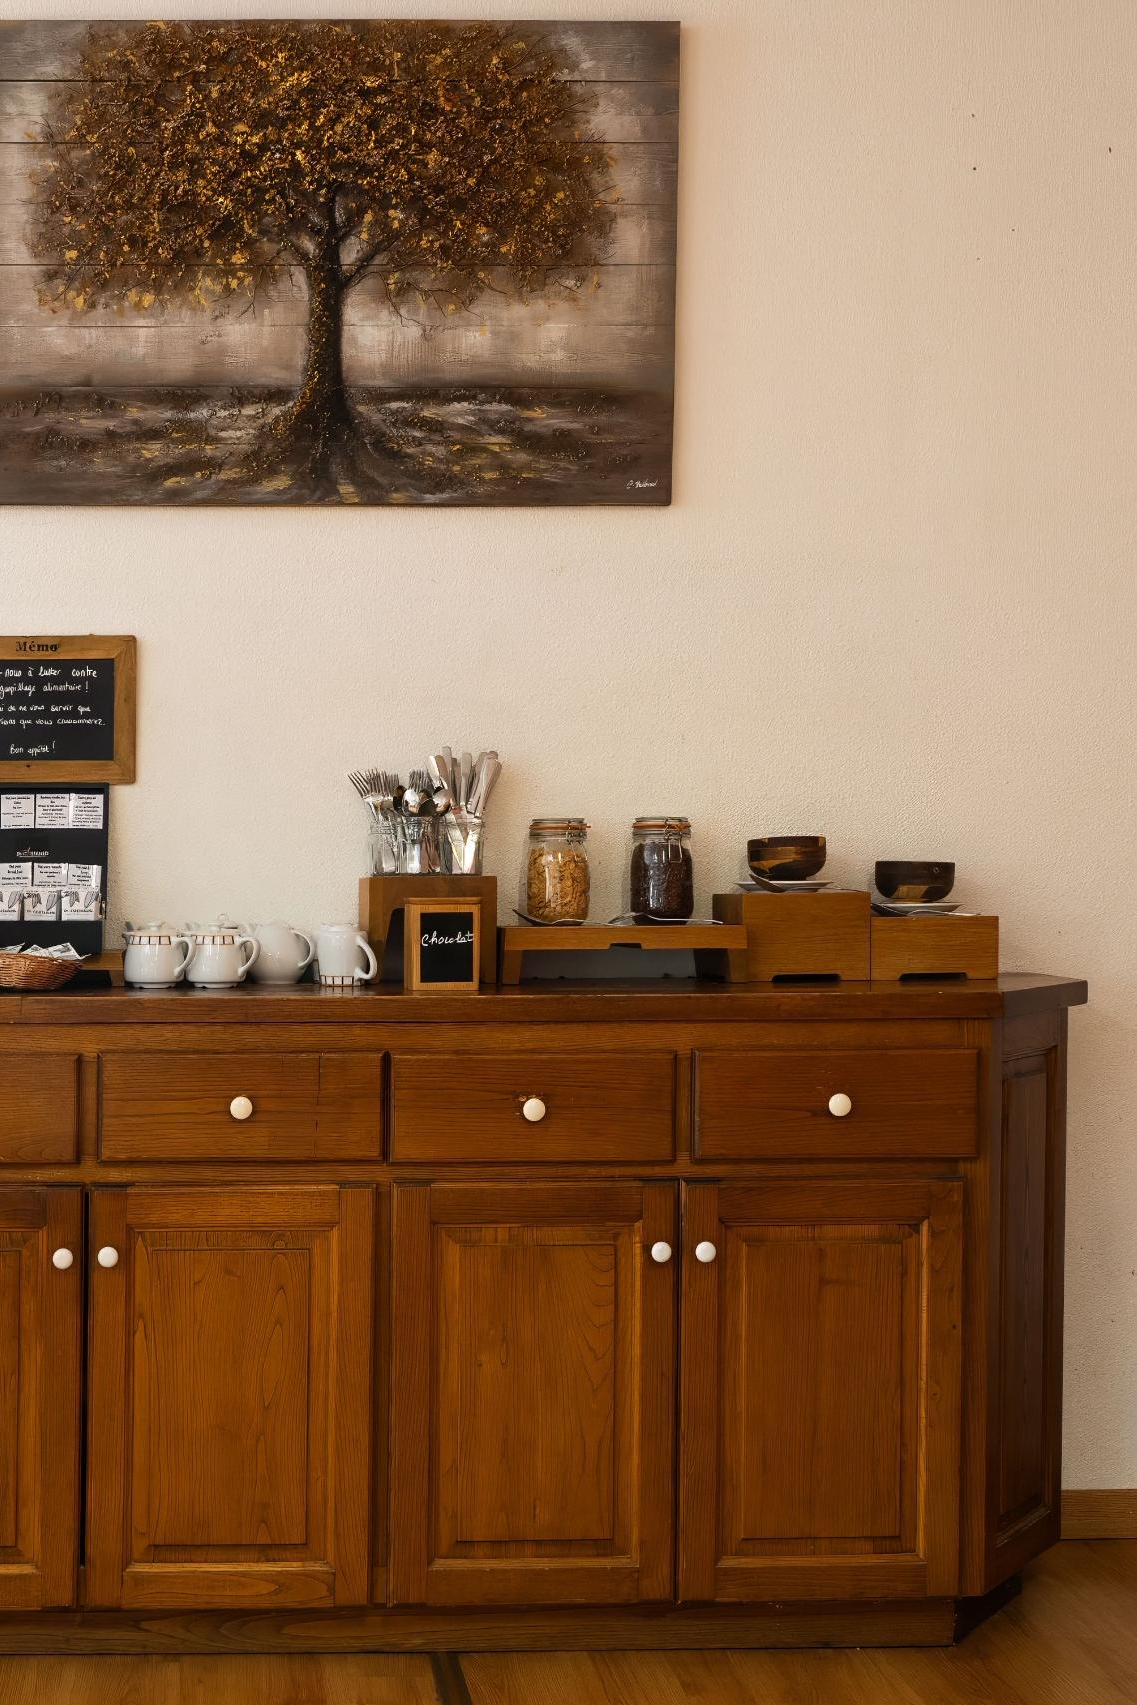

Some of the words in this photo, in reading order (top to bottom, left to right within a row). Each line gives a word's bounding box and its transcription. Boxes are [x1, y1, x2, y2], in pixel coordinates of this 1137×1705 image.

[16, 640, 60, 652] Mémo
[38, 665, 61, 678] lutter
[71, 665, 97, 678] contre
[0, 683, 36, 700] gaspillage
[50, 704, 73, 712] servir
[77, 705, 91, 715] que
[19, 719, 32, 729] que
[10, 743, 24, 755] Bon
[421, 930, 475, 947] Chocolat
